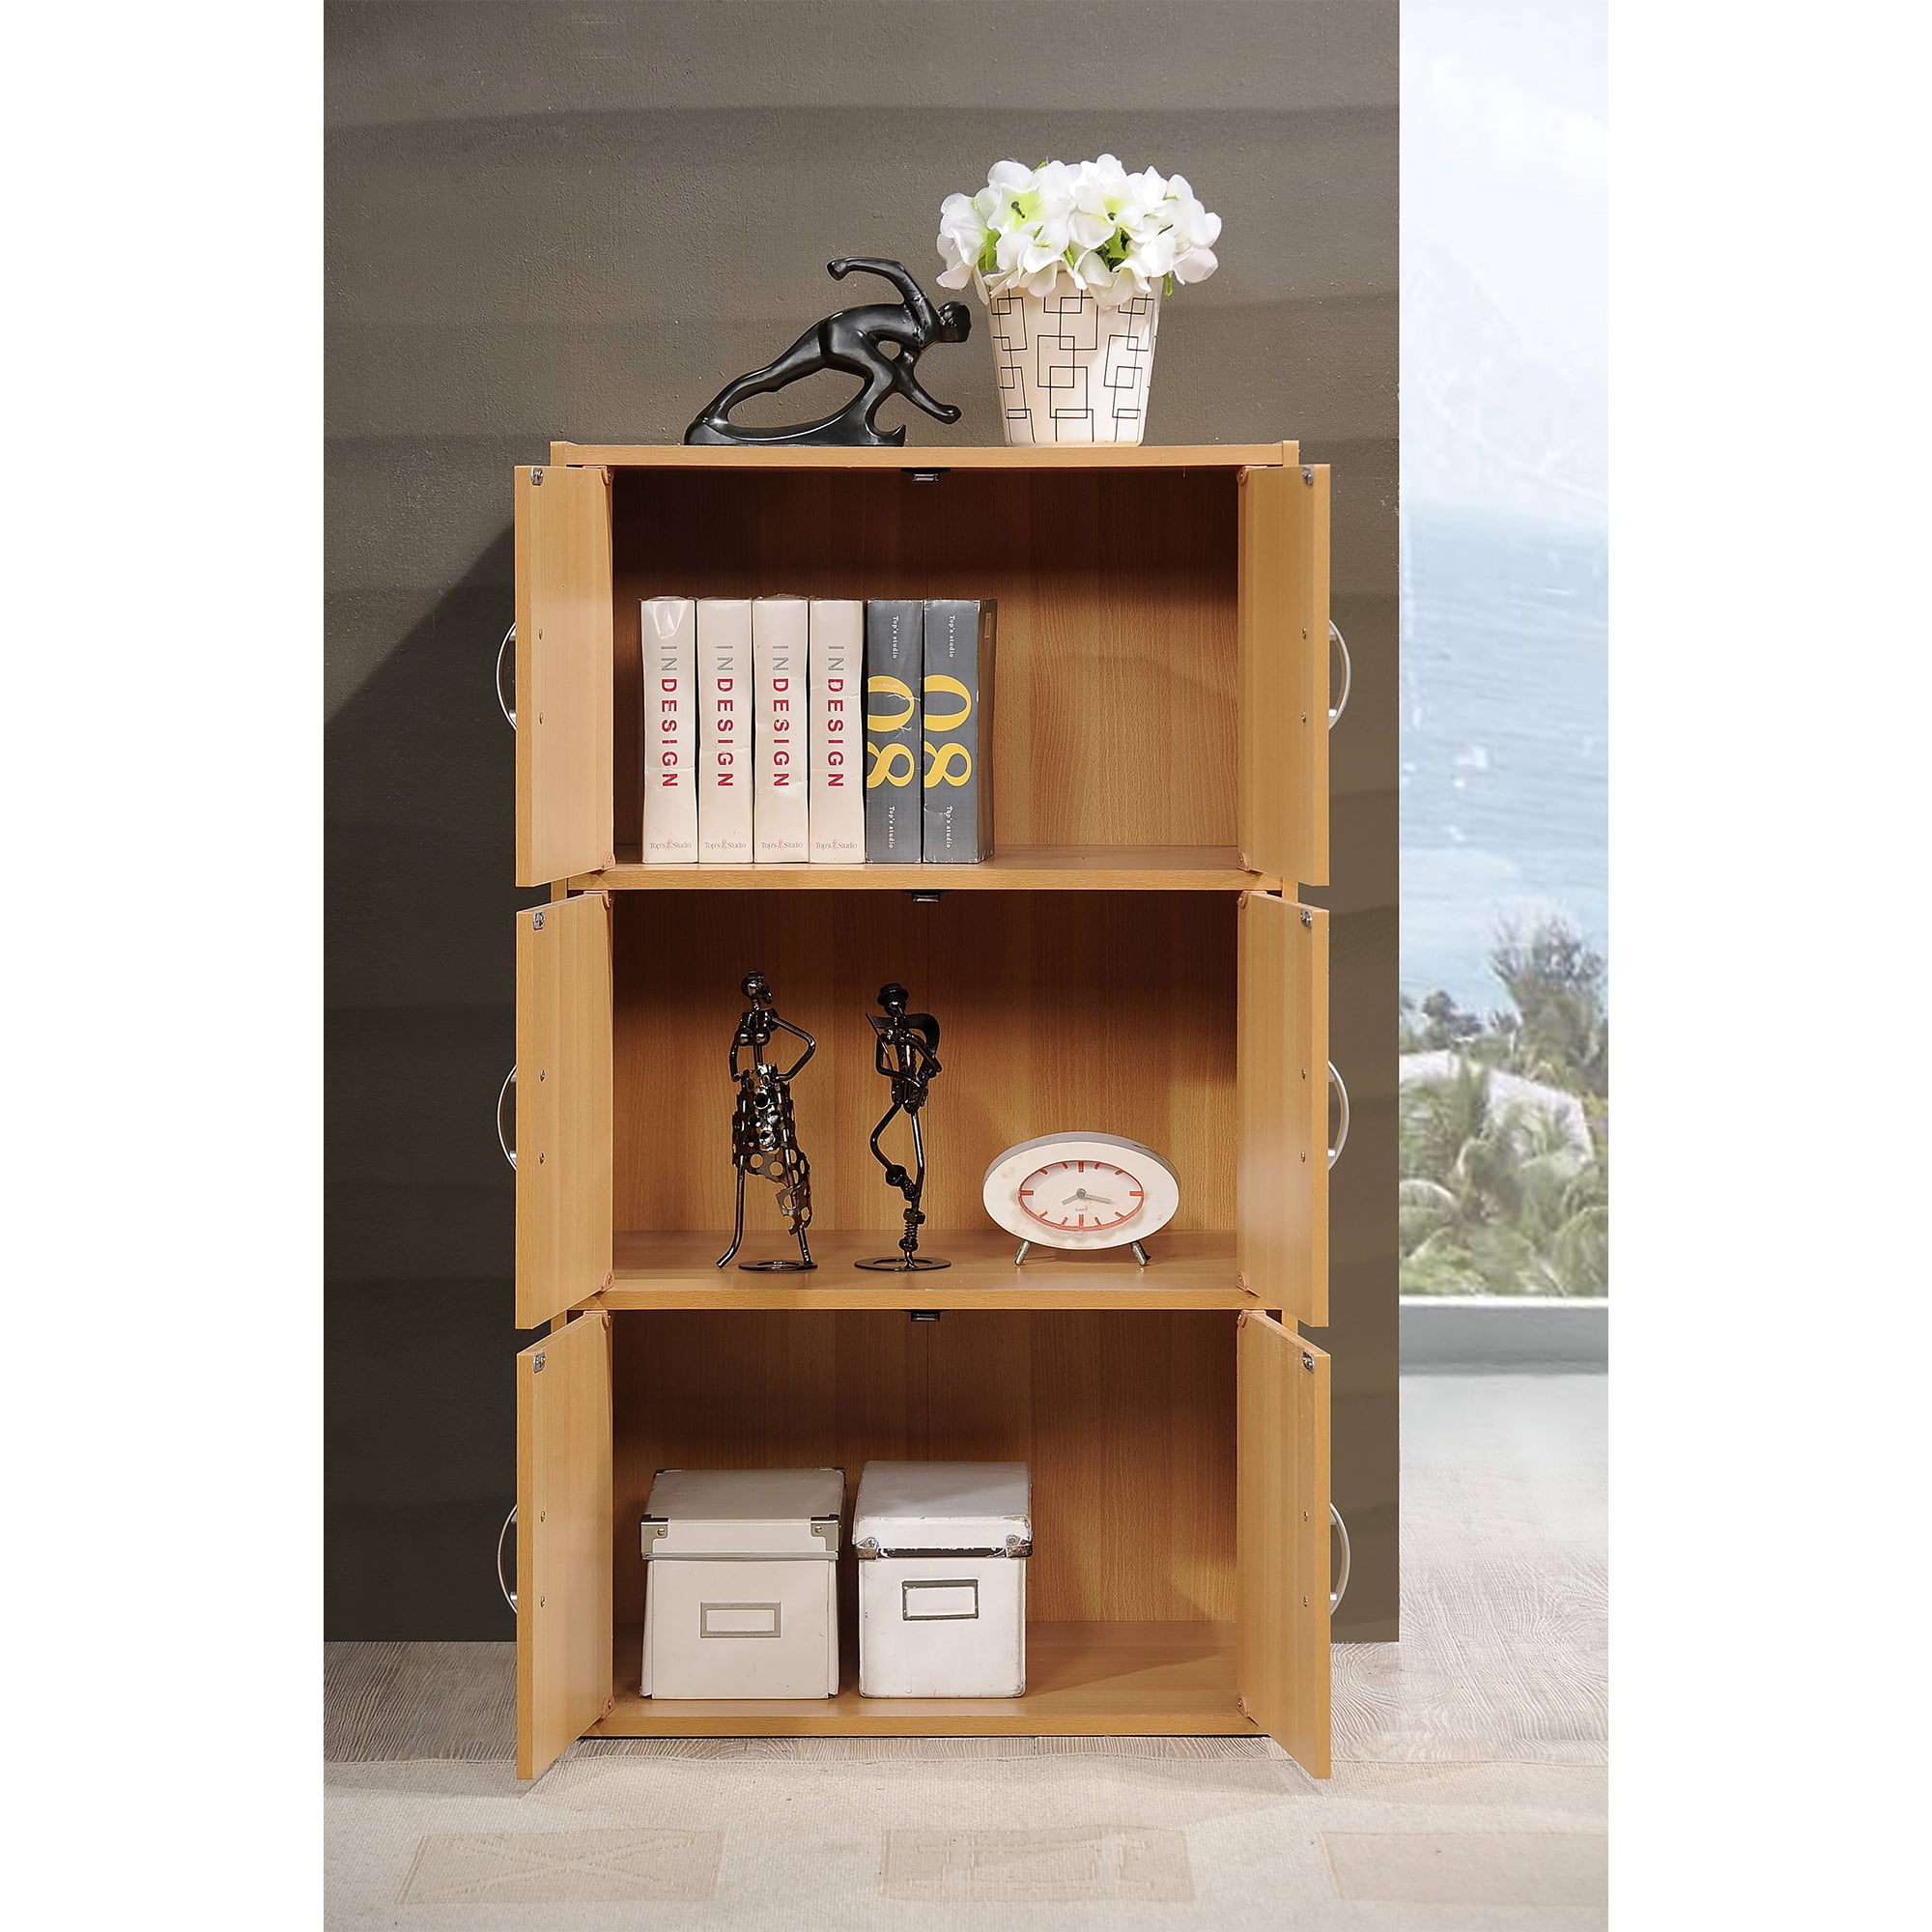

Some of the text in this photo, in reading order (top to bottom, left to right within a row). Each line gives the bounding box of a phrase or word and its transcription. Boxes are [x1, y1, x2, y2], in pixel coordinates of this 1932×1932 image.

[661, 645, 678, 787] INDESIGN
[716, 645, 734, 787] INDESIGN
[773, 645, 790, 787] INDESIGN
[827, 645, 844, 787] INDESIGN
